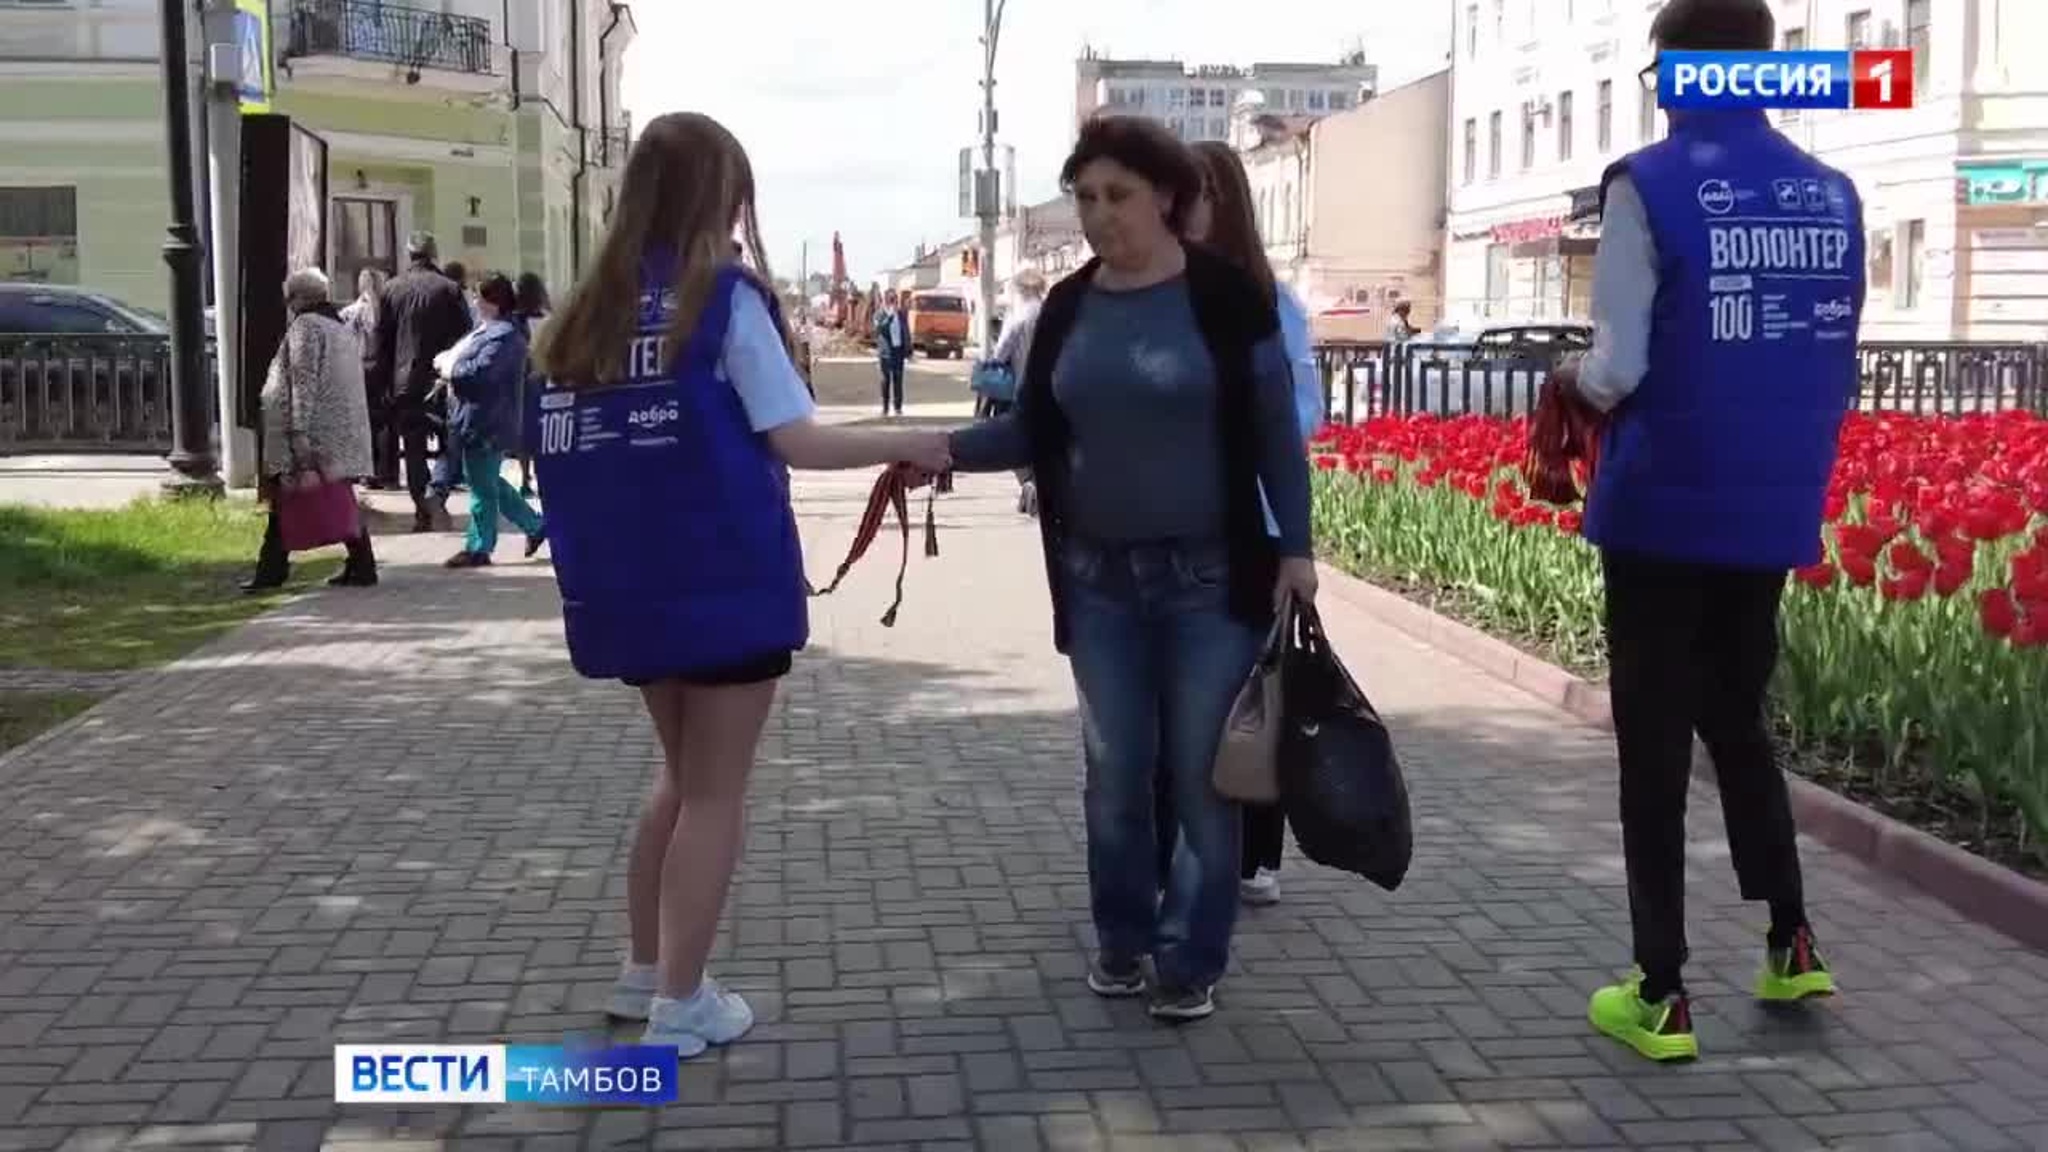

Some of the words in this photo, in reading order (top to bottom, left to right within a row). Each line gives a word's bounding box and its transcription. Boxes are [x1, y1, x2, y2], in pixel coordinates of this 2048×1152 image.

[1709, 227, 1849, 270] ВОЛОНТЕР
[1709, 295, 1752, 340] 100
[540, 411, 574, 455] 100
